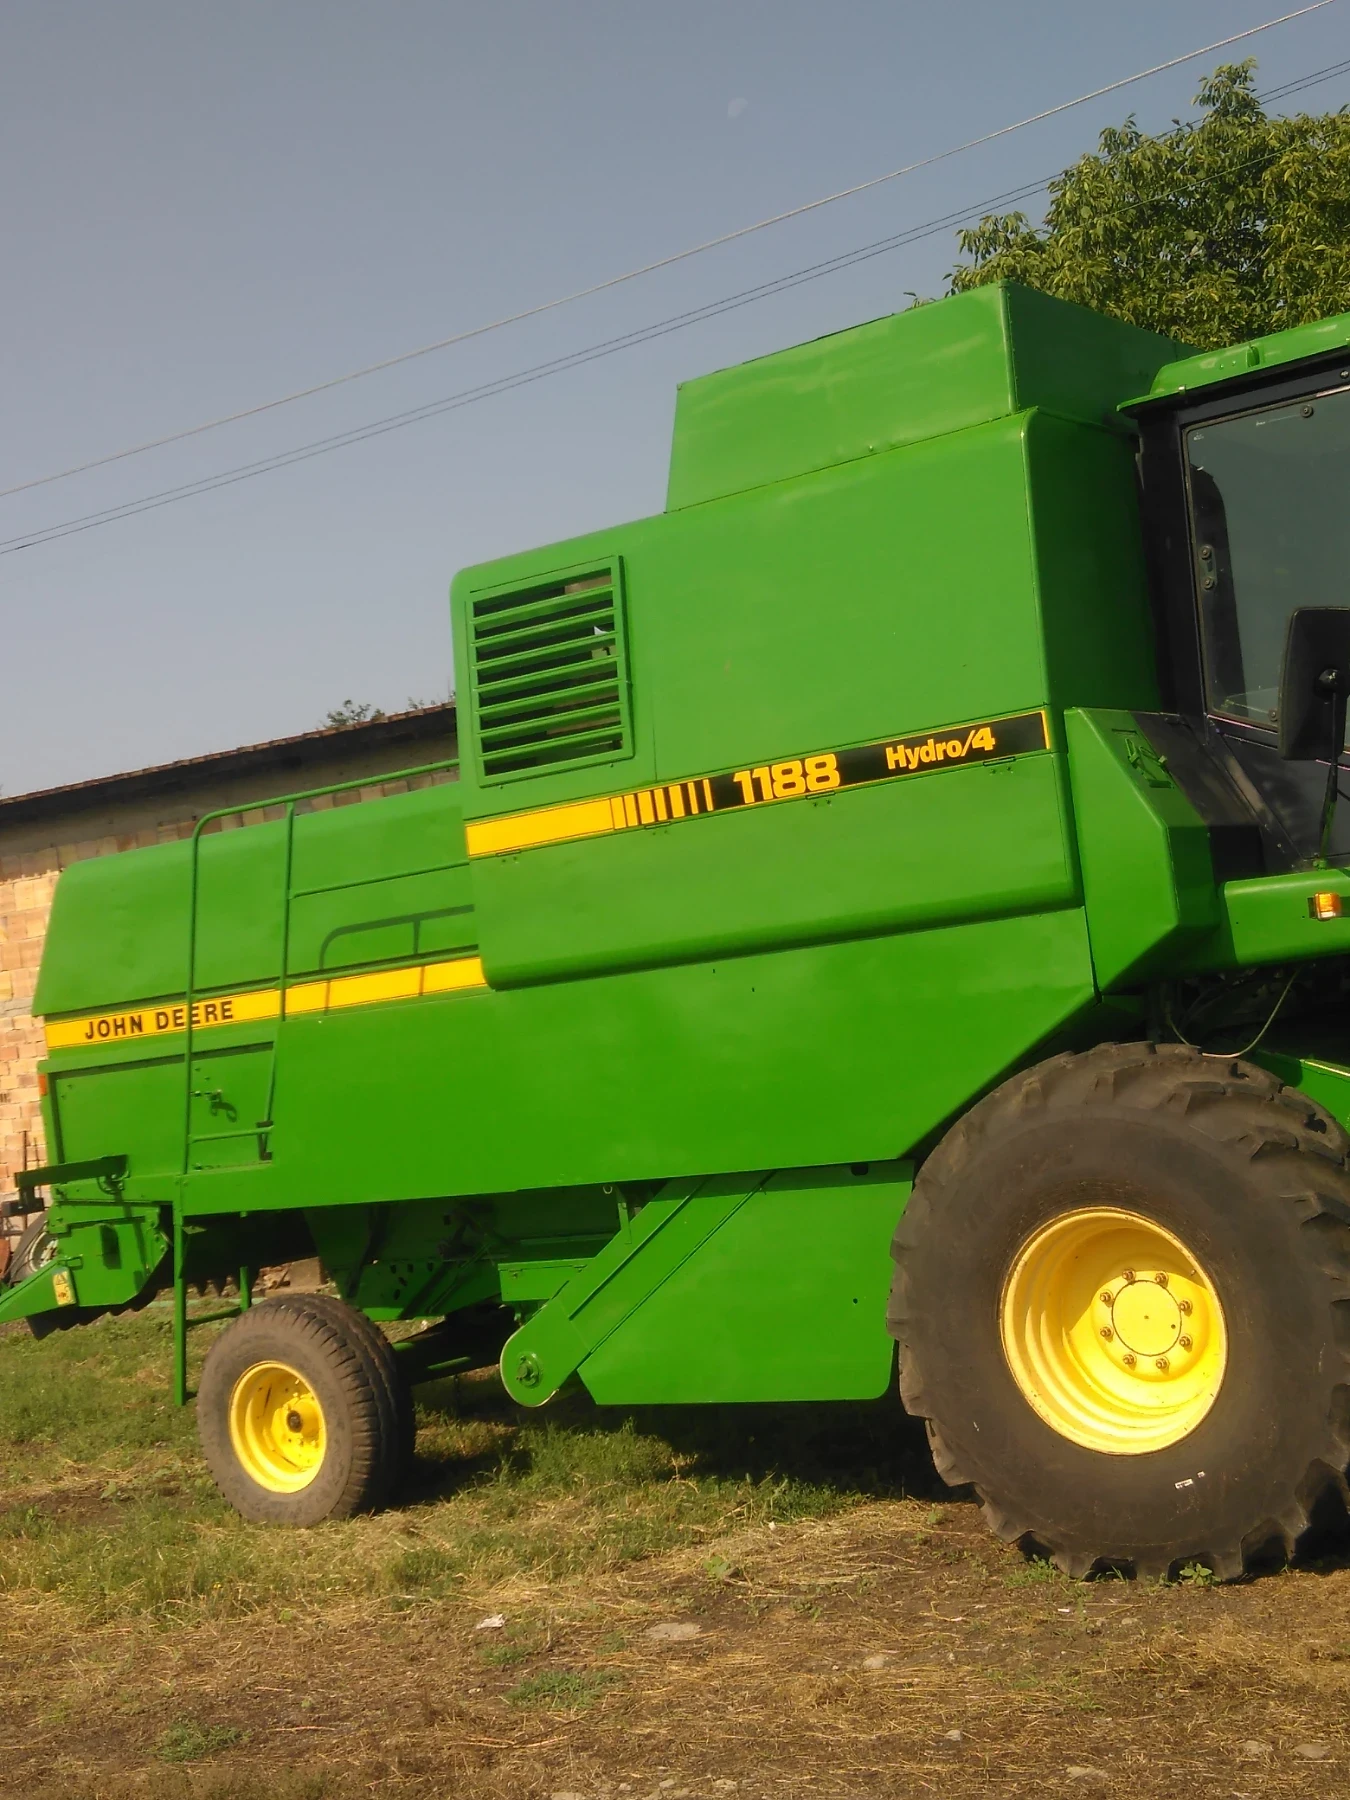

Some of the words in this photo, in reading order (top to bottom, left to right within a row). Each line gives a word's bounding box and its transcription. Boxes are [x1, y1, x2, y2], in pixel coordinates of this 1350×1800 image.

[733, 753, 840, 804] 1188
[886, 727, 995, 769] Hydro/4
[85, 1015, 143, 1040] JOHN
[156, 1000, 233, 1030] DEERE
